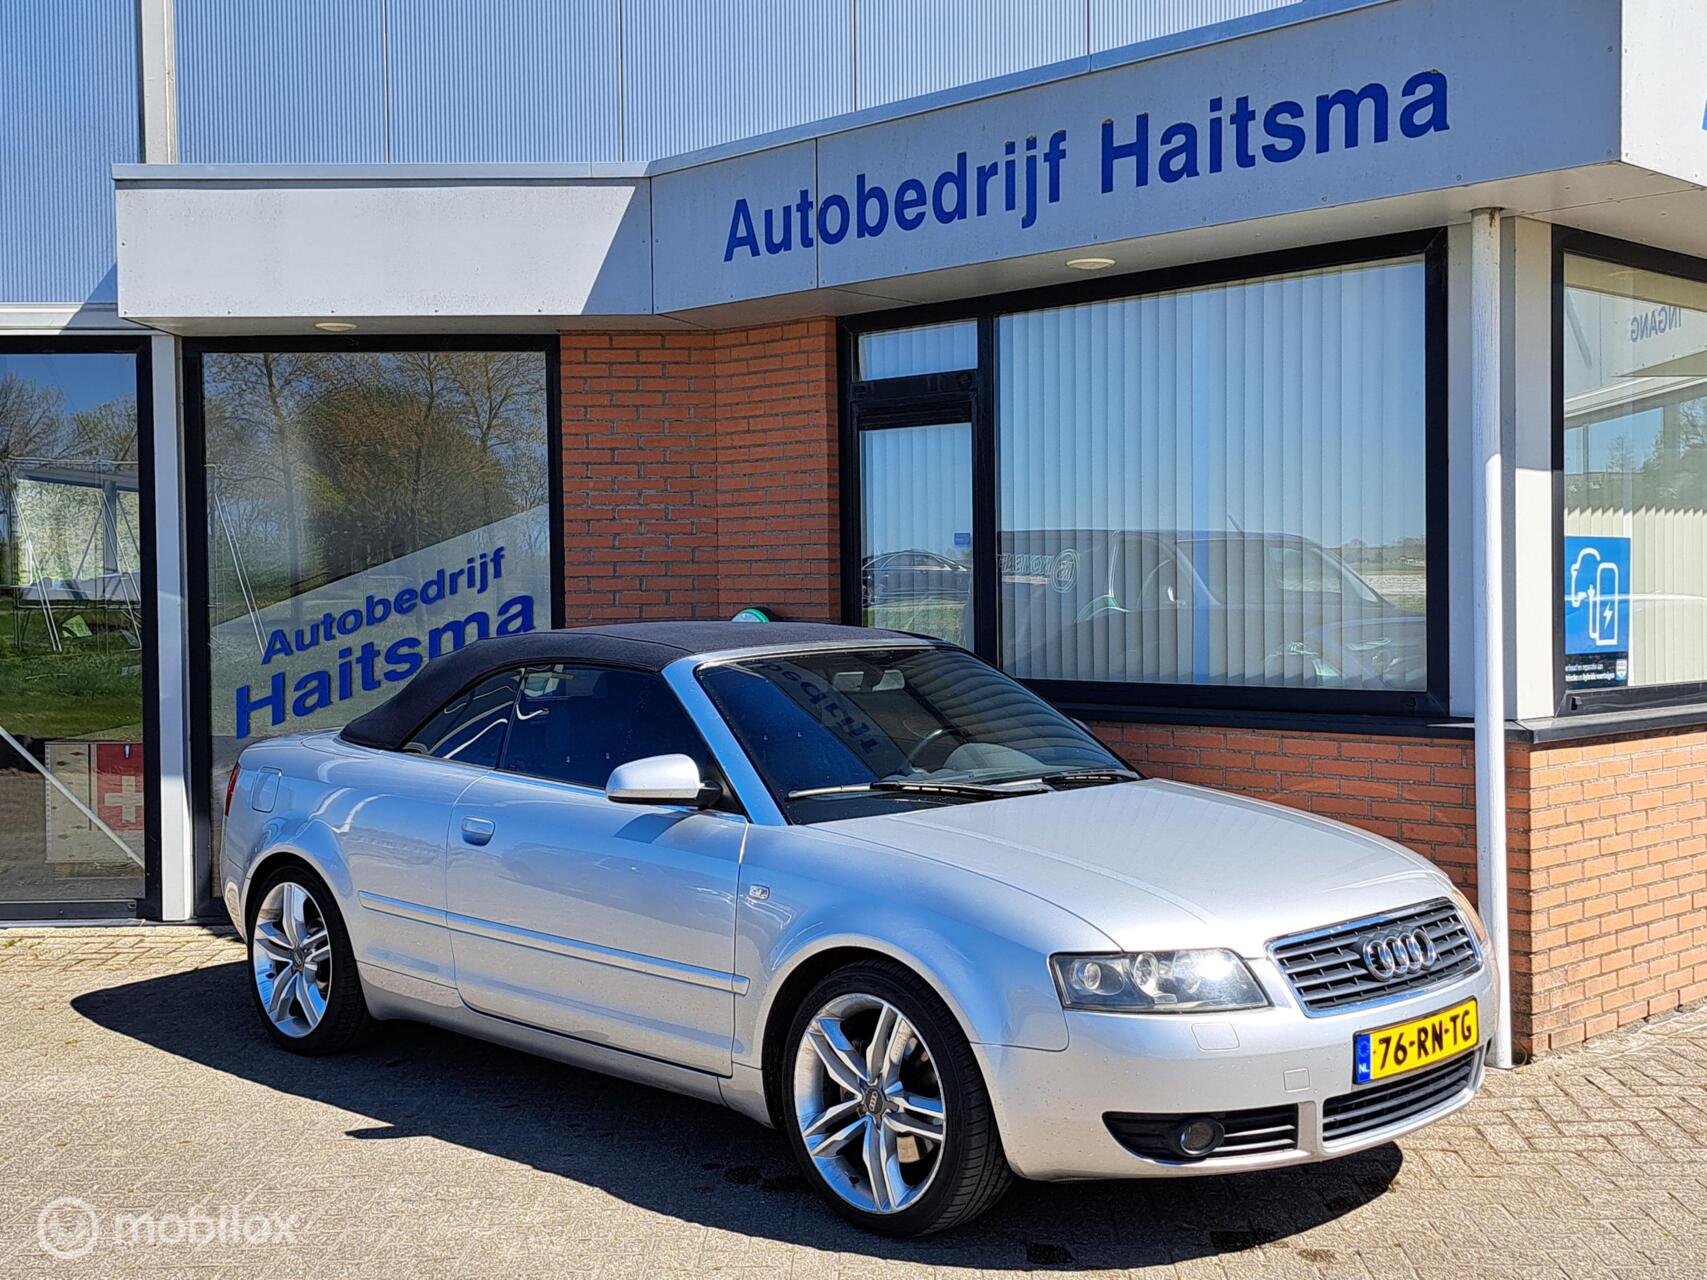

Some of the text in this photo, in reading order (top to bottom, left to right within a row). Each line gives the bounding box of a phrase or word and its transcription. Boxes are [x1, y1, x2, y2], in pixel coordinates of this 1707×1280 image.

[724, 69, 1451, 263] Autobedrijf Haitsma
[261, 546, 506, 666] Autobedrijf
[236, 594, 535, 741] Haitsma
[1358, 1062, 1369, 1074] NL
[1378, 1009, 1472, 1071] 76-RN-TG
